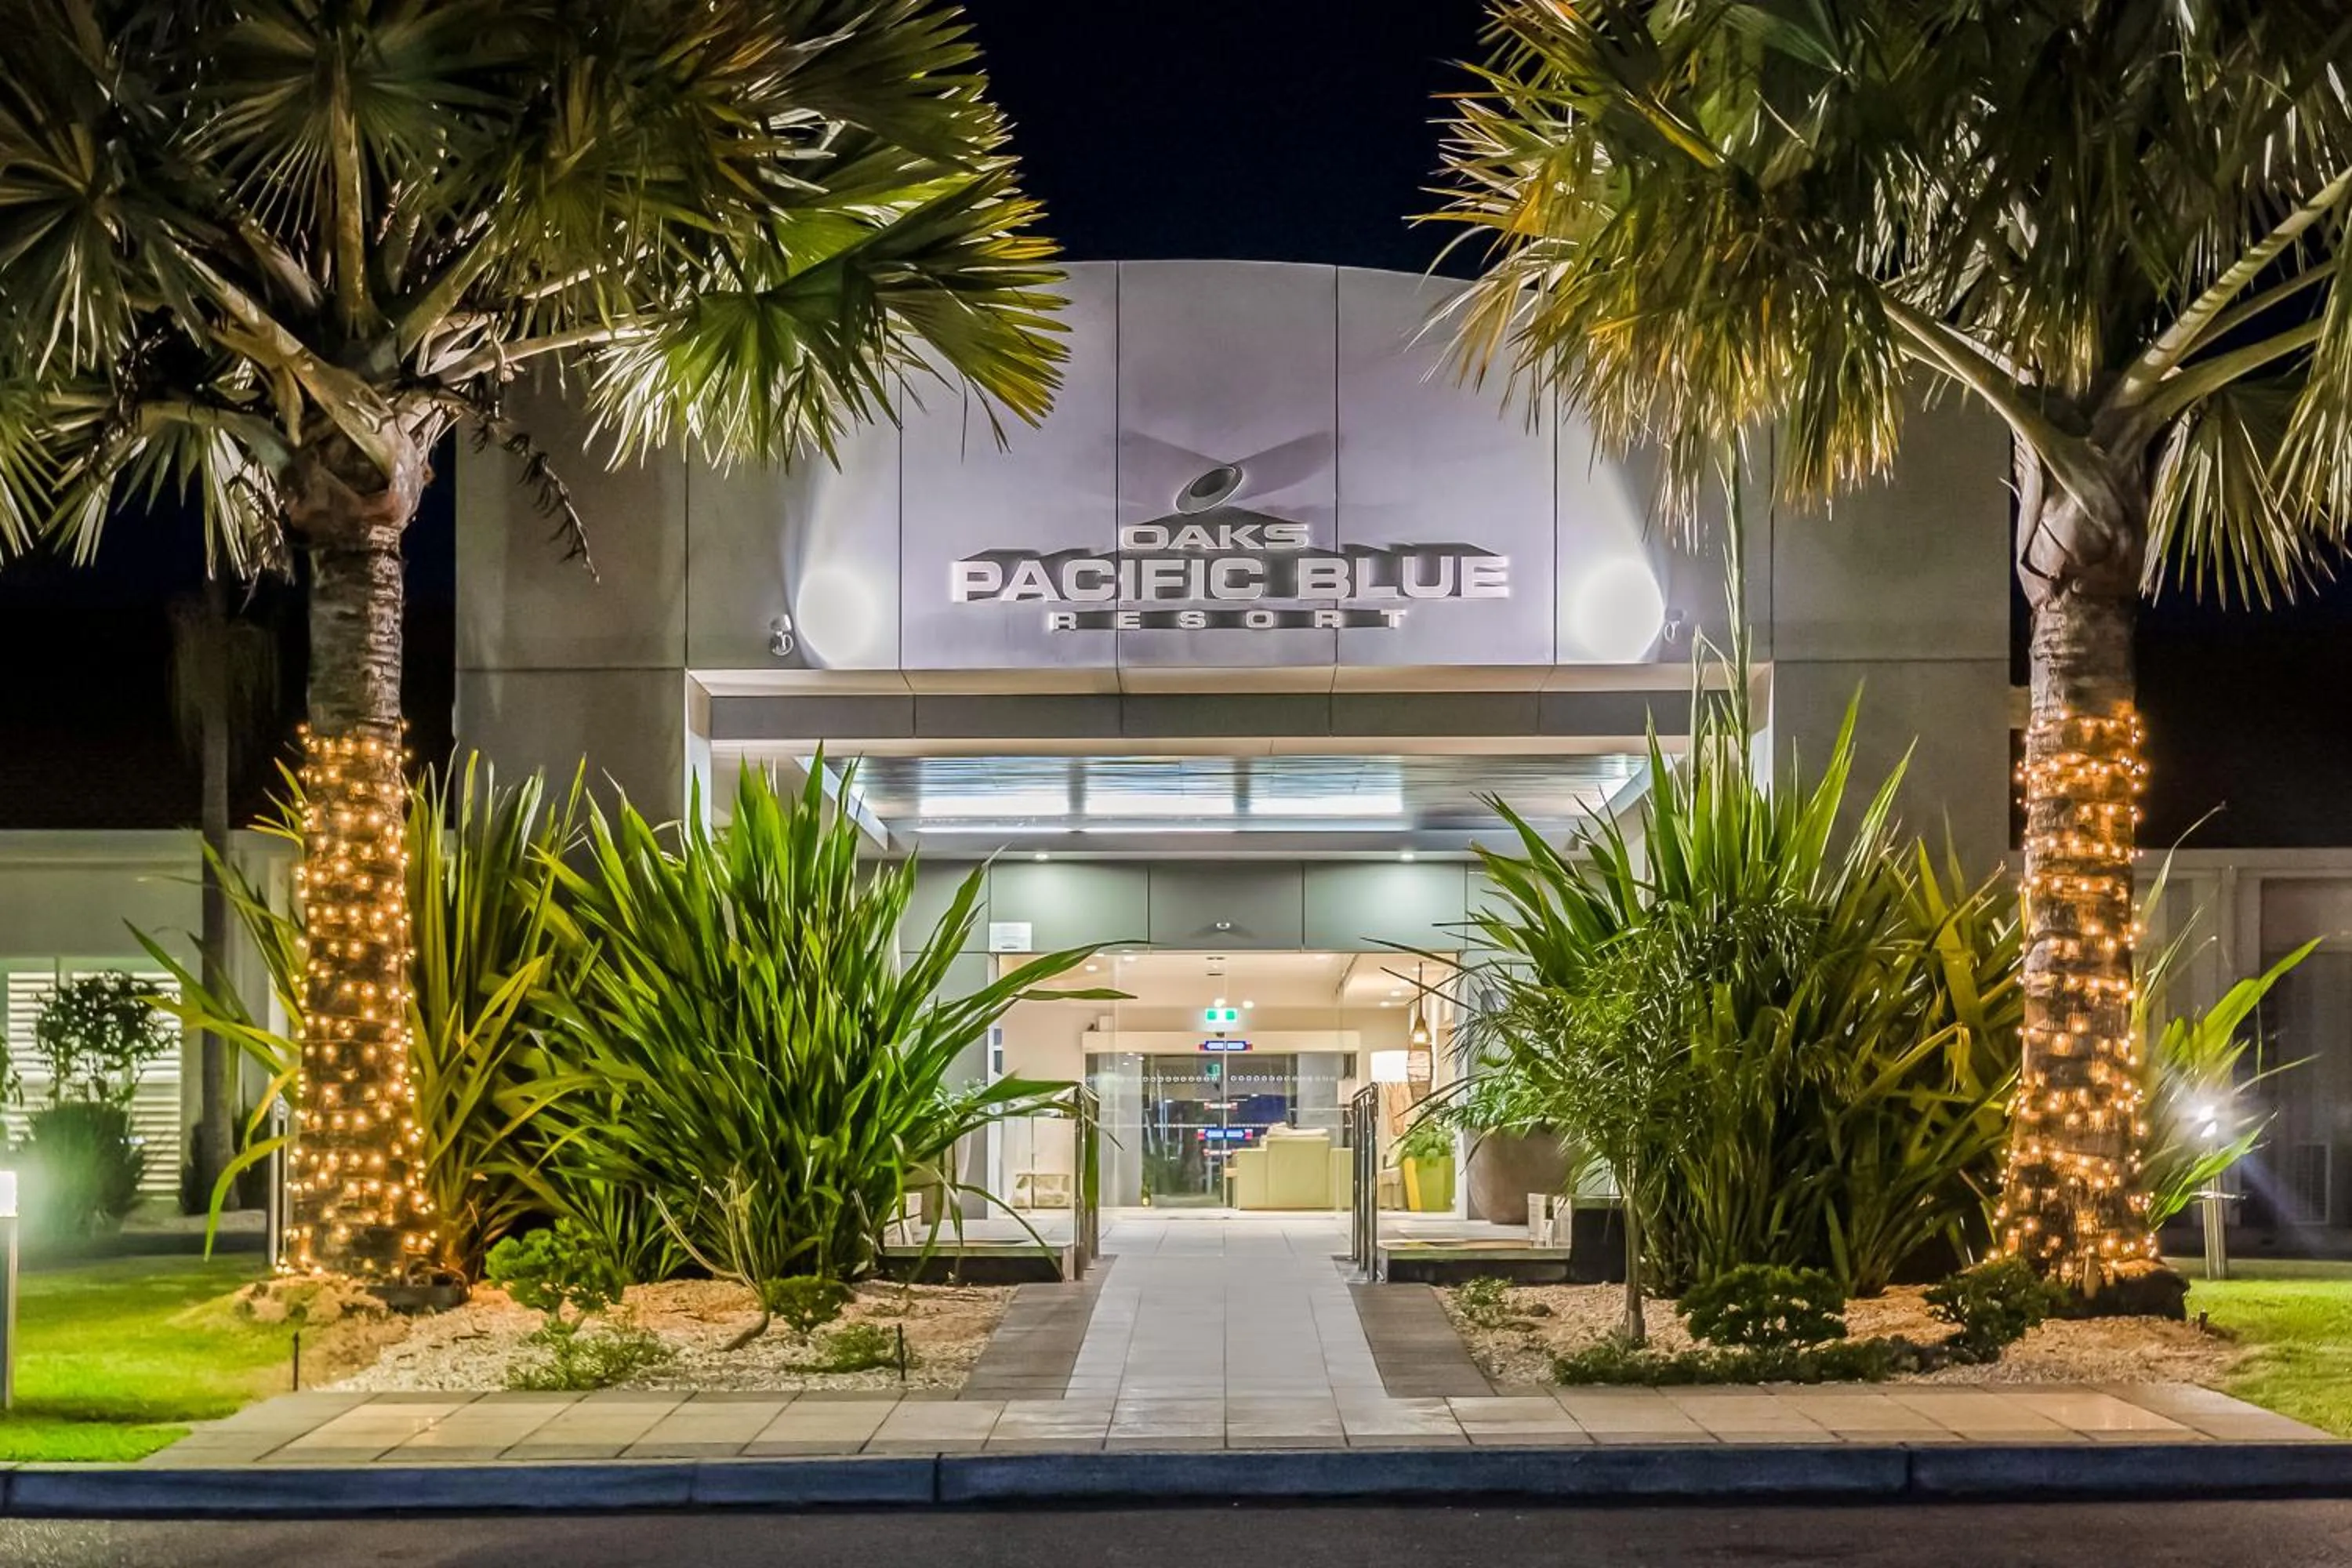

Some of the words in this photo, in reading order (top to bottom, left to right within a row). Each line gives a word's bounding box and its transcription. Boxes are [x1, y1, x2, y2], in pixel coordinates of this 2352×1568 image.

[1121, 524, 1309, 550] OAKS
[952, 557, 1264, 602] PACIFIC
[1298, 556, 1510, 600] BLUE
[1049, 609, 1406, 630] RESORT
